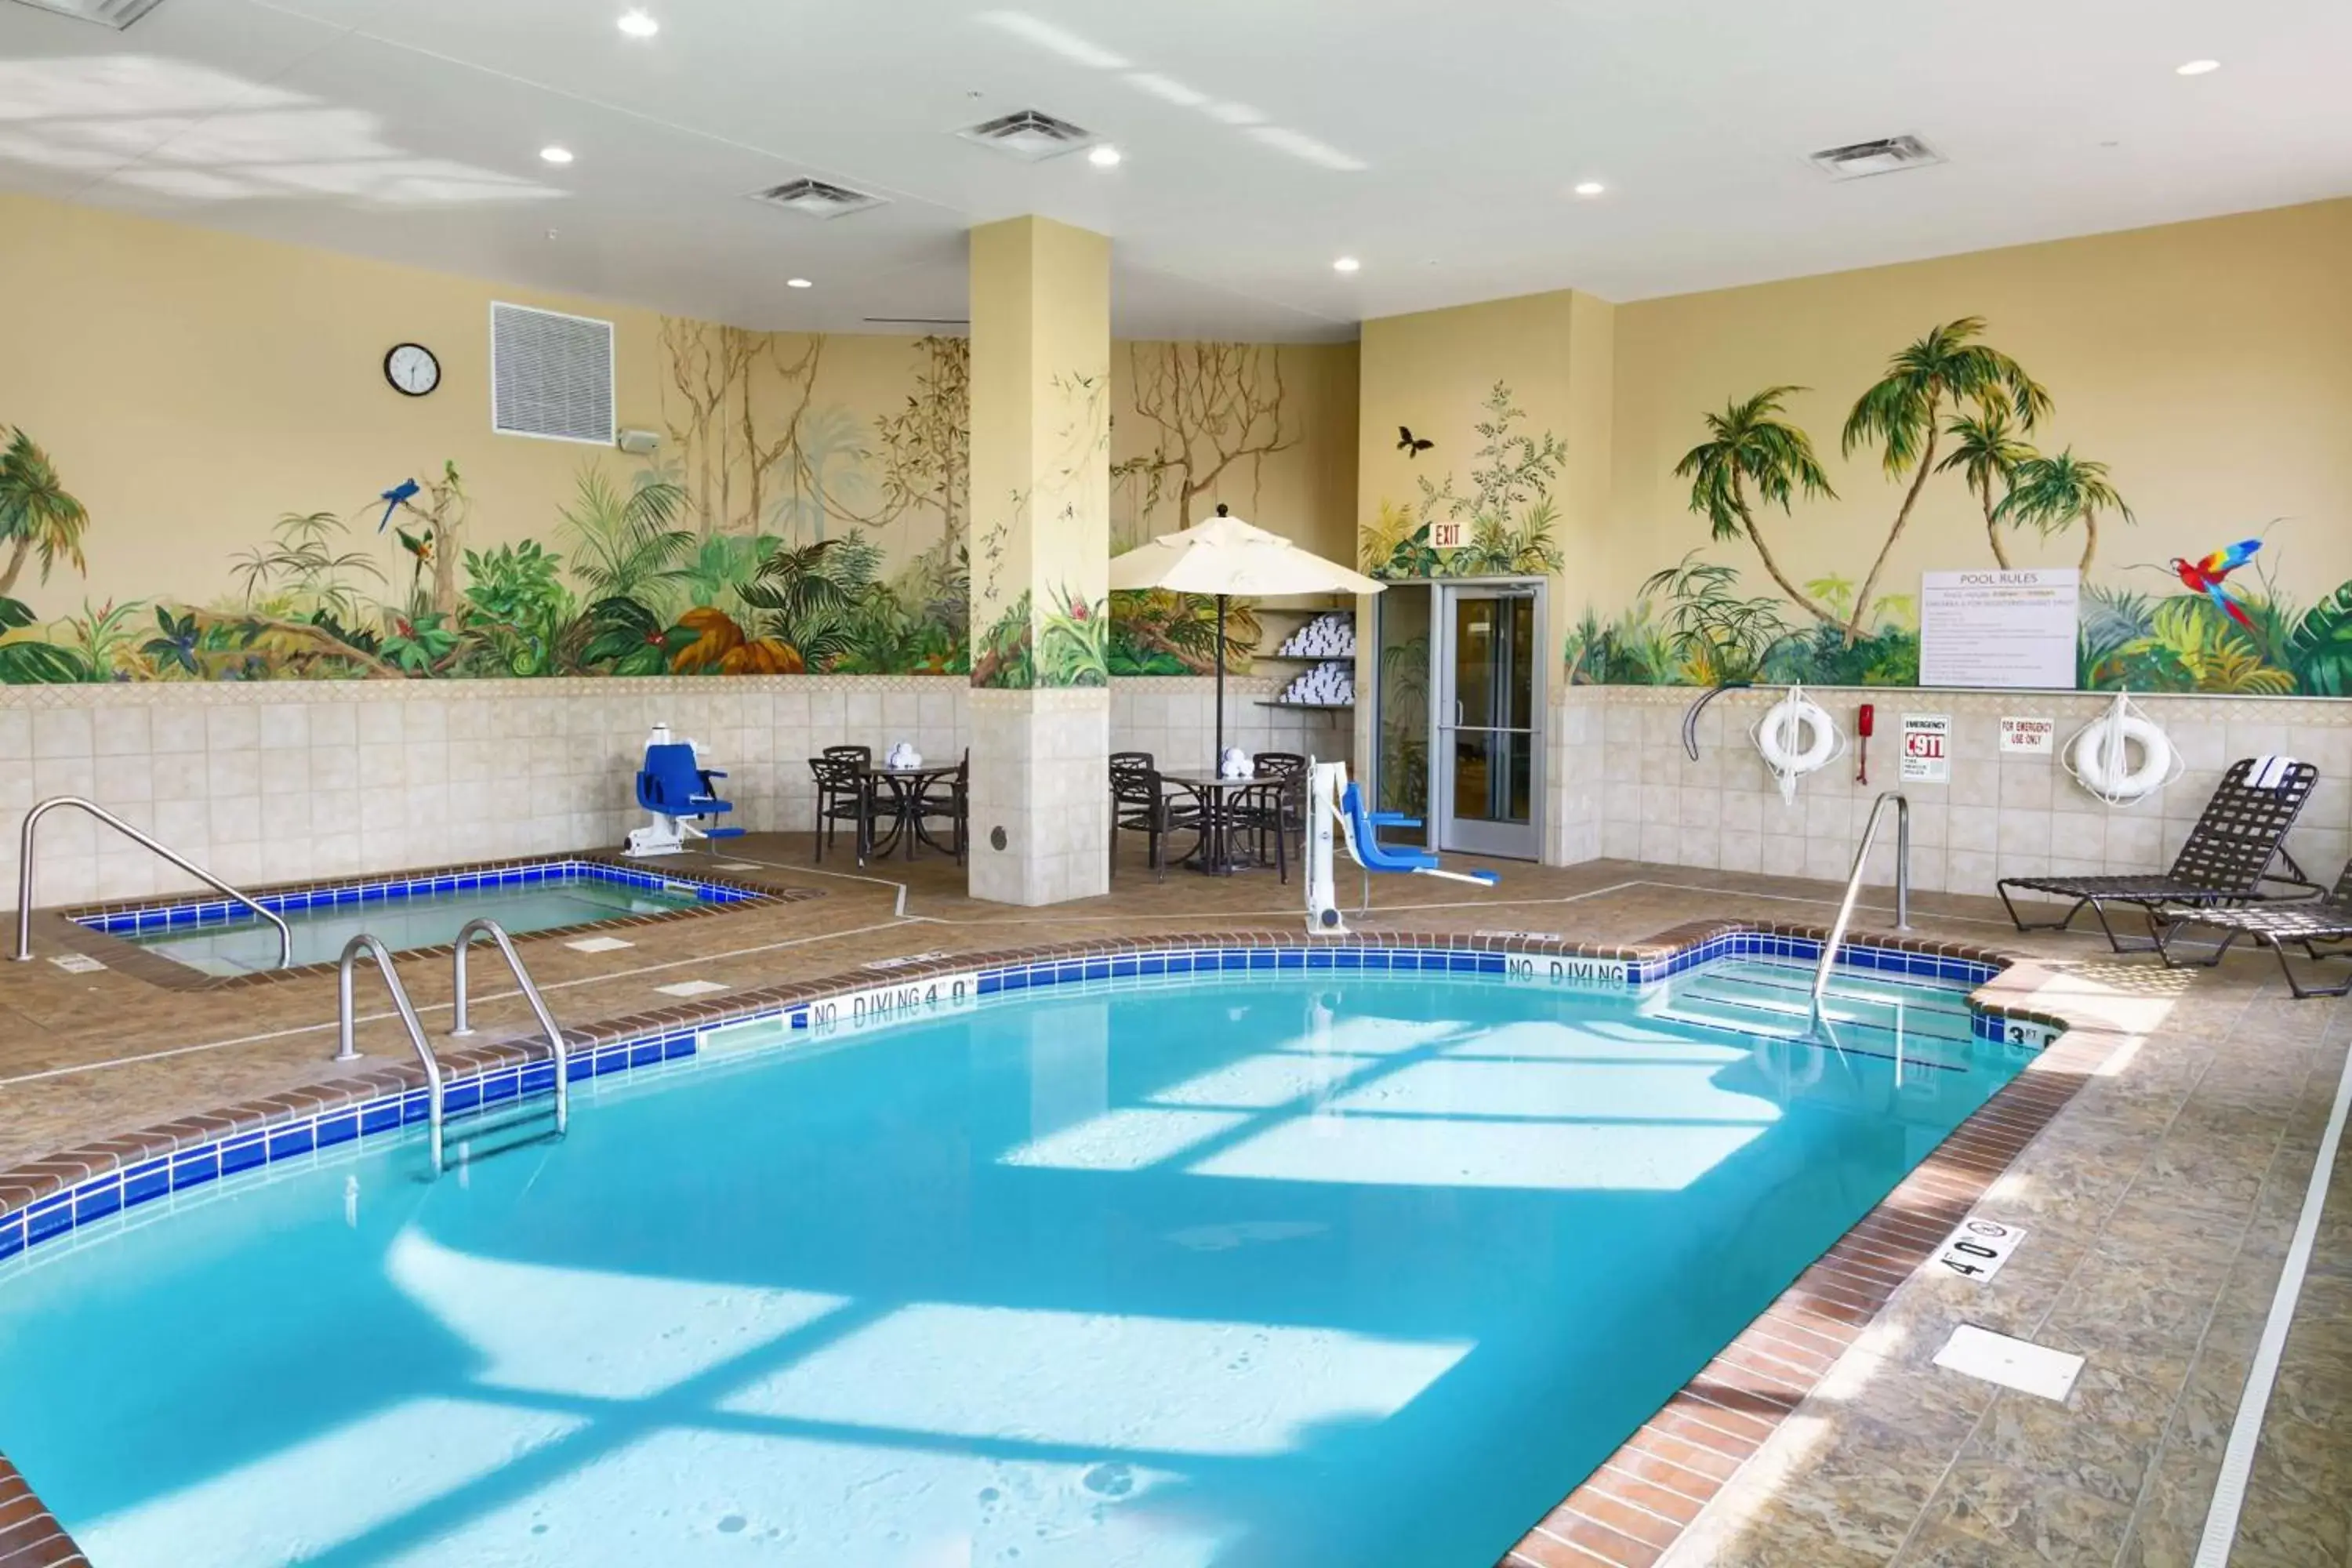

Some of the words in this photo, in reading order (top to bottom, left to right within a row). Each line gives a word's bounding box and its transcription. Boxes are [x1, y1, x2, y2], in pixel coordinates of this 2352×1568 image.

[1436, 524, 1460, 545] EXIT
[1960, 574, 1994, 584] POOL
[1999, 573, 2038, 583] RULES
[1906, 720, 1944, 729] EMERGENCY
[2002, 721, 2013, 731] FOR
[2016, 721, 2052, 732] EMERGENCY
[1915, 735, 1944, 756] 911
[2012, 734, 2023, 744] USE
[2026, 735, 2041, 745] ONLY
[1509, 959, 1533, 976] NO
[1550, 961, 1623, 981] DIVING
[815, 1004, 837, 1025] NO
[854, 988, 920, 1018] DIVING
[925, 984, 937, 1003] 4
[953, 981, 965, 997] 0
[2009, 1026, 2024, 1044] 3
[2025, 1029, 2038, 1039] FT
[1940, 1258, 1984, 1275] 4
